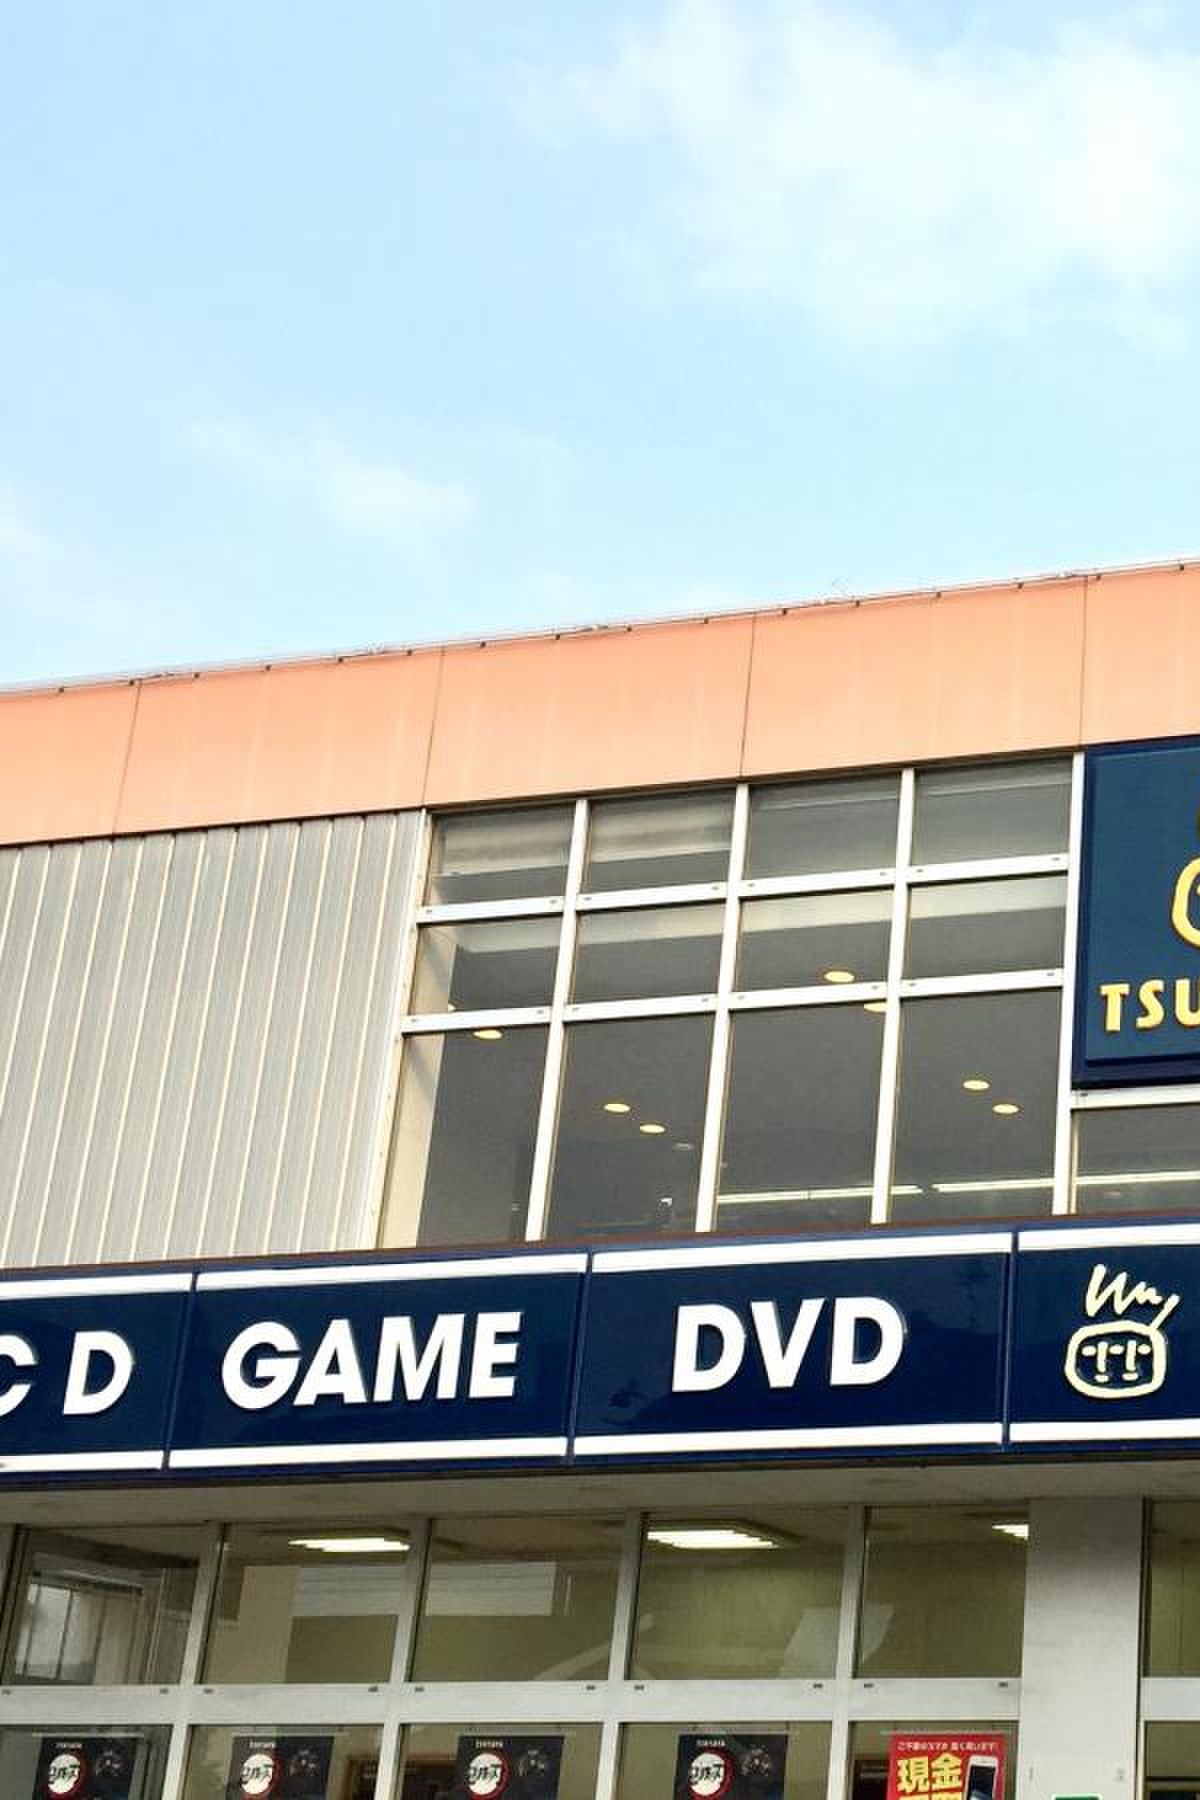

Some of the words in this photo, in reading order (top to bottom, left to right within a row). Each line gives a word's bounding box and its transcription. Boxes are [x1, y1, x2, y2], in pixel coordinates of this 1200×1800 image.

[221, 1310, 522, 1411] GAME
[671, 1296, 906, 1392] DVD
[897, 1753, 963, 1792] 現金
